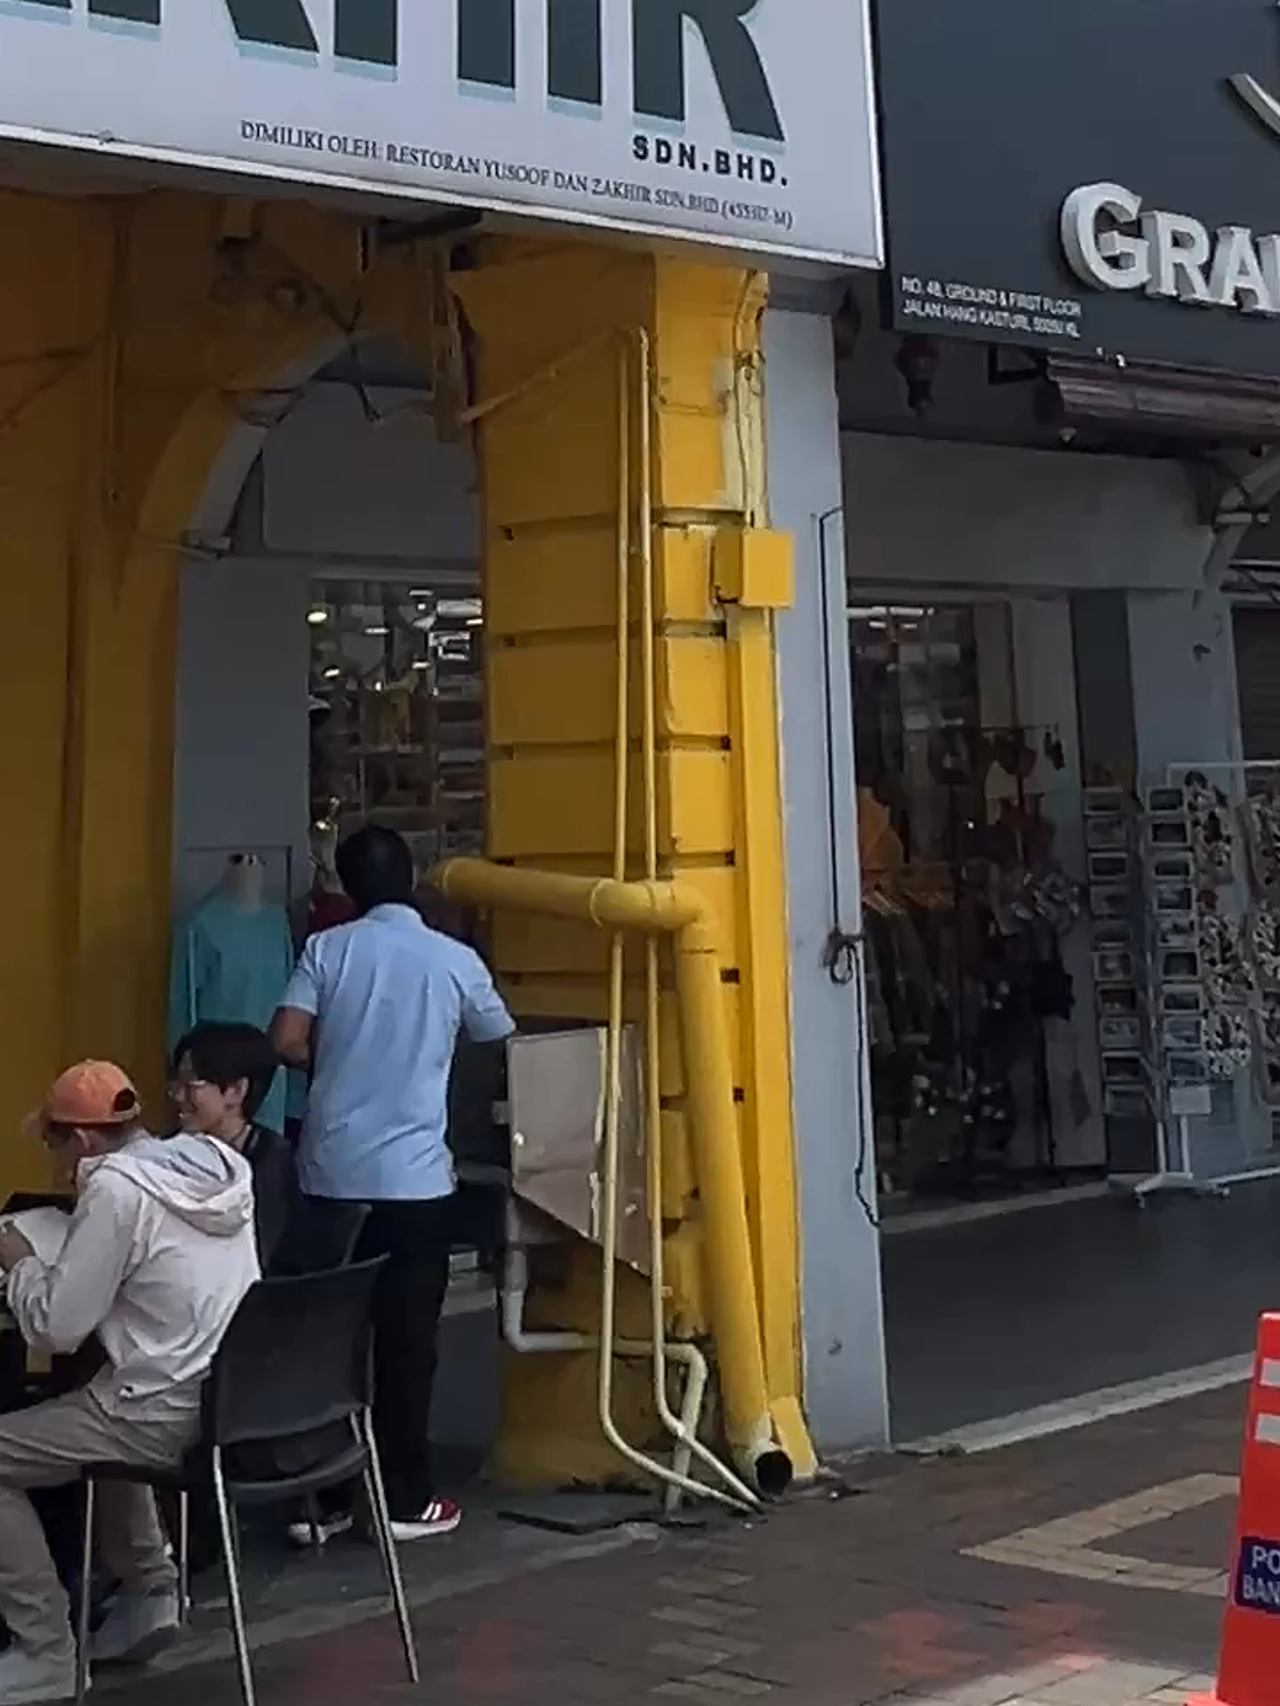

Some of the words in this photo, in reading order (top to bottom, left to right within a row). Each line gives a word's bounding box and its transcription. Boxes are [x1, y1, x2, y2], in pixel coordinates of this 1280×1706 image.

[240, 120, 323, 151] DIMILIKI
[386, 143, 480, 174] RESTORAN
[553, 169, 587, 192] DAN
